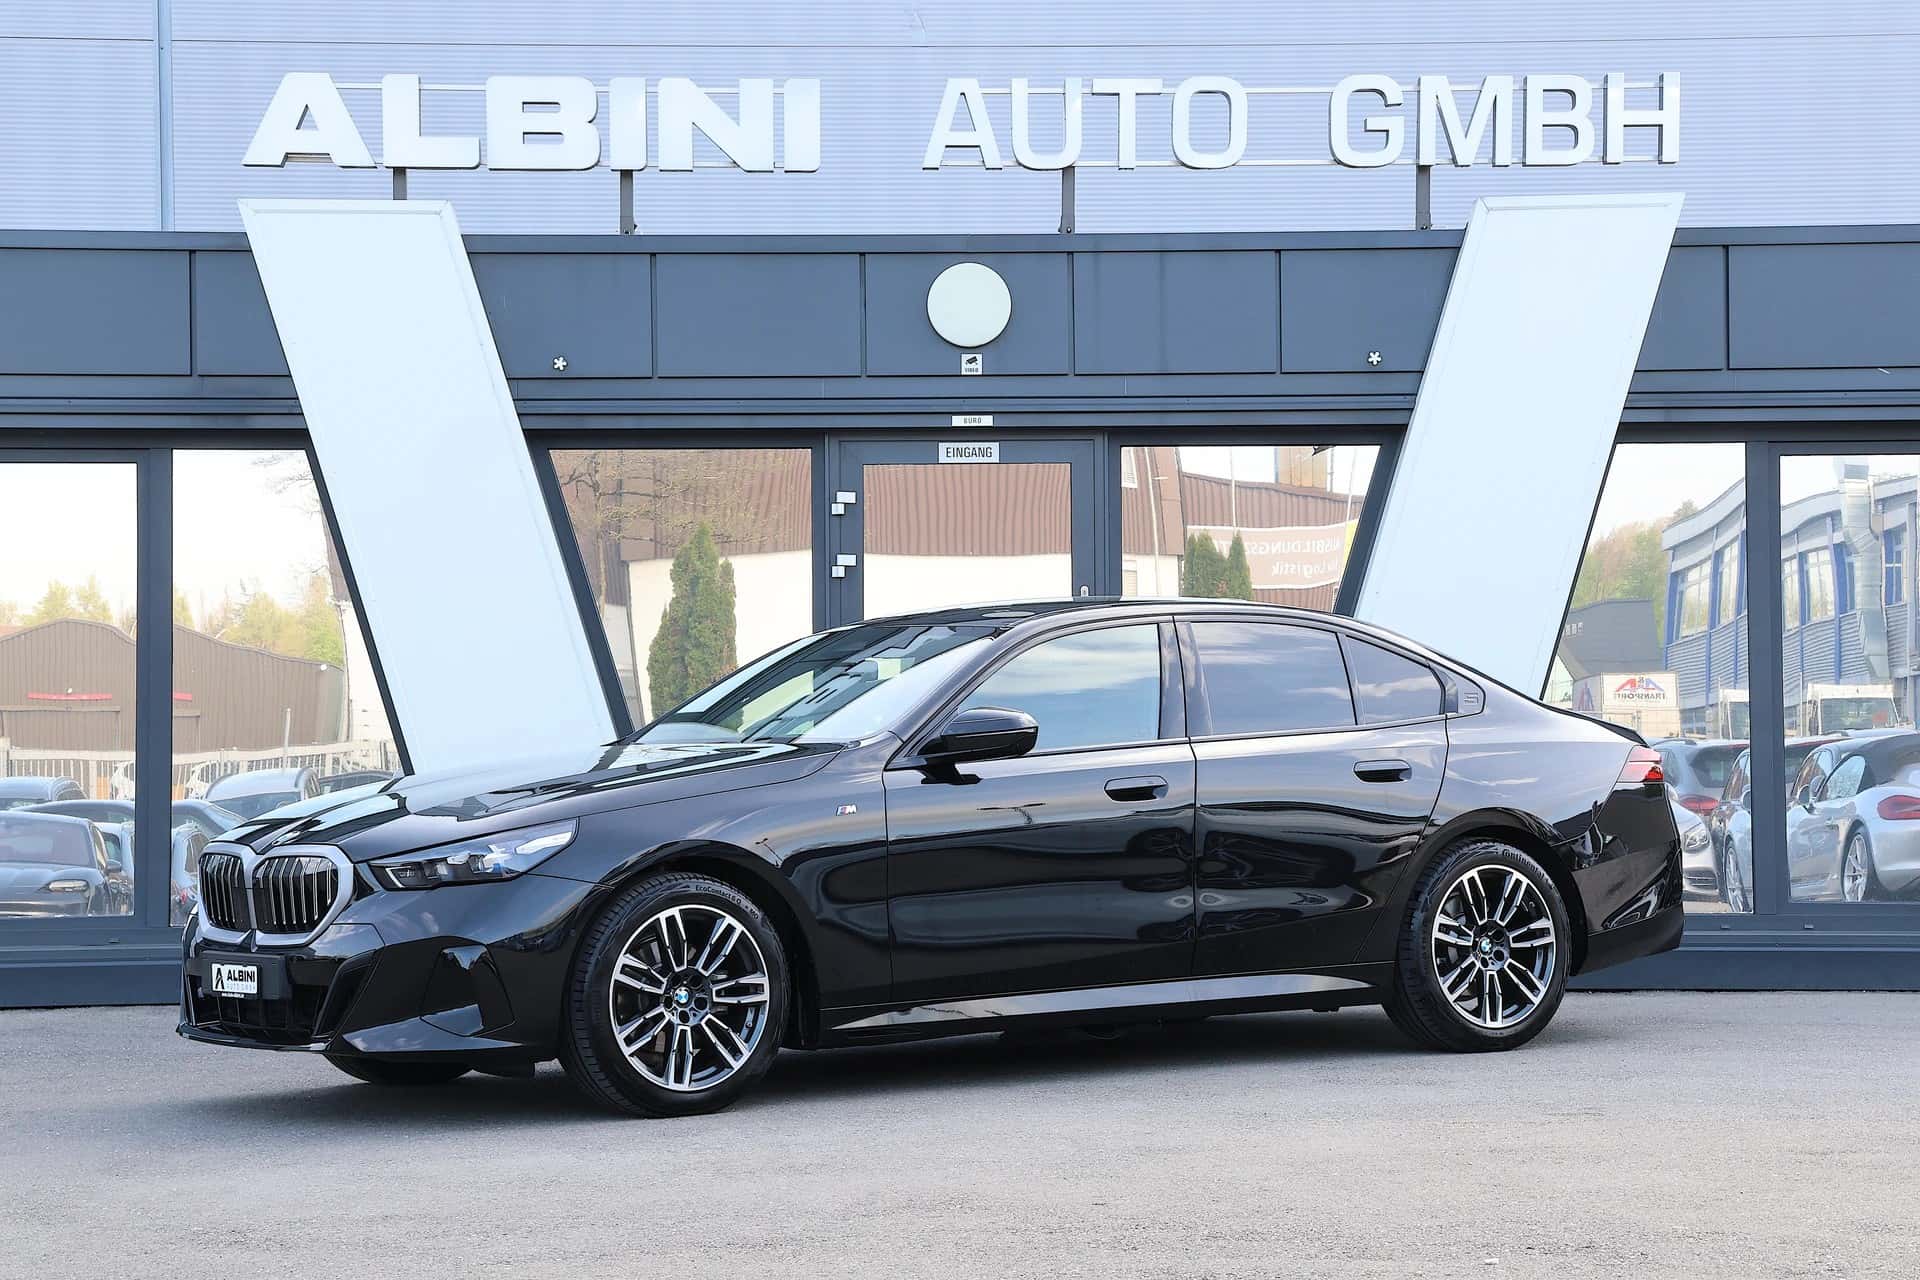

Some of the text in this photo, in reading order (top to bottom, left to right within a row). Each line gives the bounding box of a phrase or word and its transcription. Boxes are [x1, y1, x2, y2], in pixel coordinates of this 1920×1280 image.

[241, 71, 1682, 173] ALBINI AUTO GMBH
[946, 447, 993, 458] EINGANG
[1502, 849, 1545, 880] Continental
[227, 969, 255, 982] ALBINI
